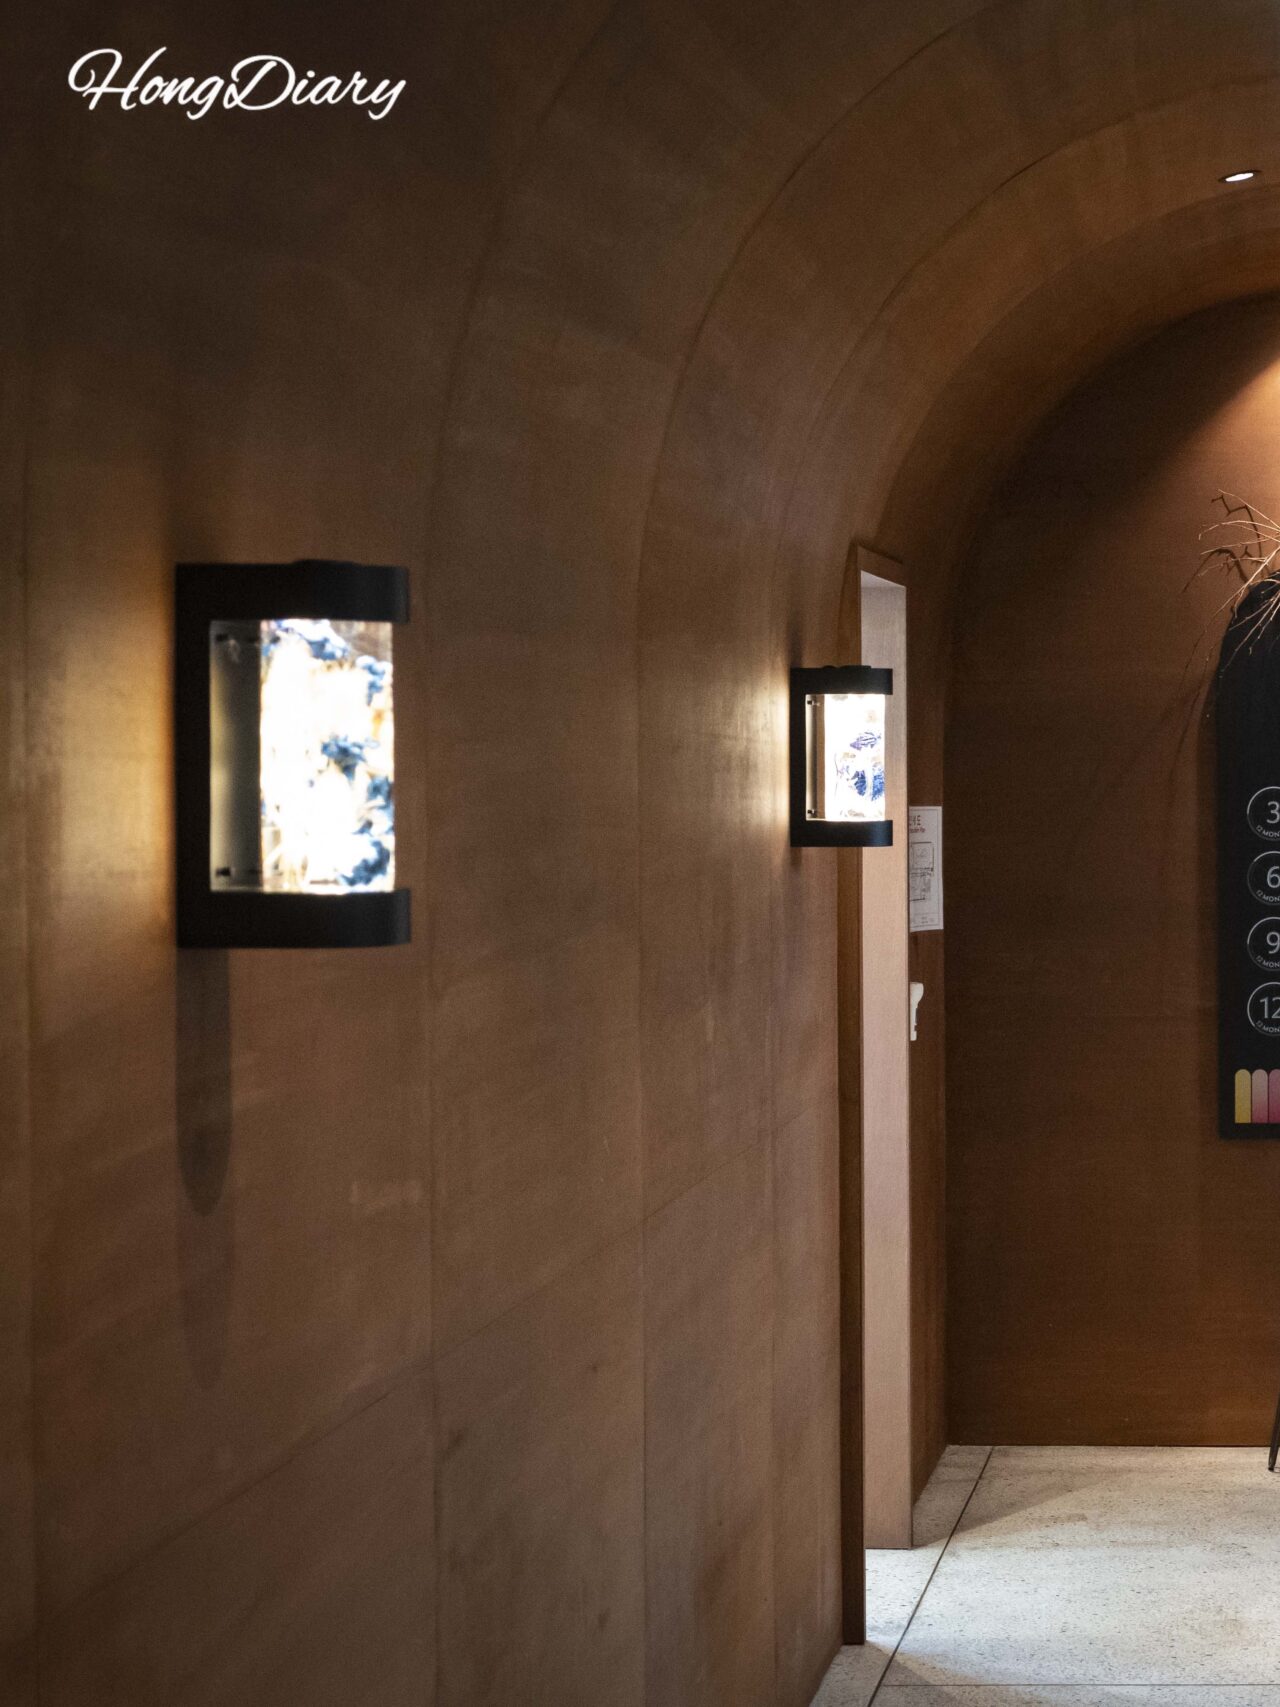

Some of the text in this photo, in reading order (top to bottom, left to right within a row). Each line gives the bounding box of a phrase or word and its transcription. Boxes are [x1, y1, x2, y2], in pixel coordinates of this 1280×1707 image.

[1266, 801, 1280, 824] 3
[1266, 866, 1280, 888] 6
[1266, 932, 1280, 954] 9
